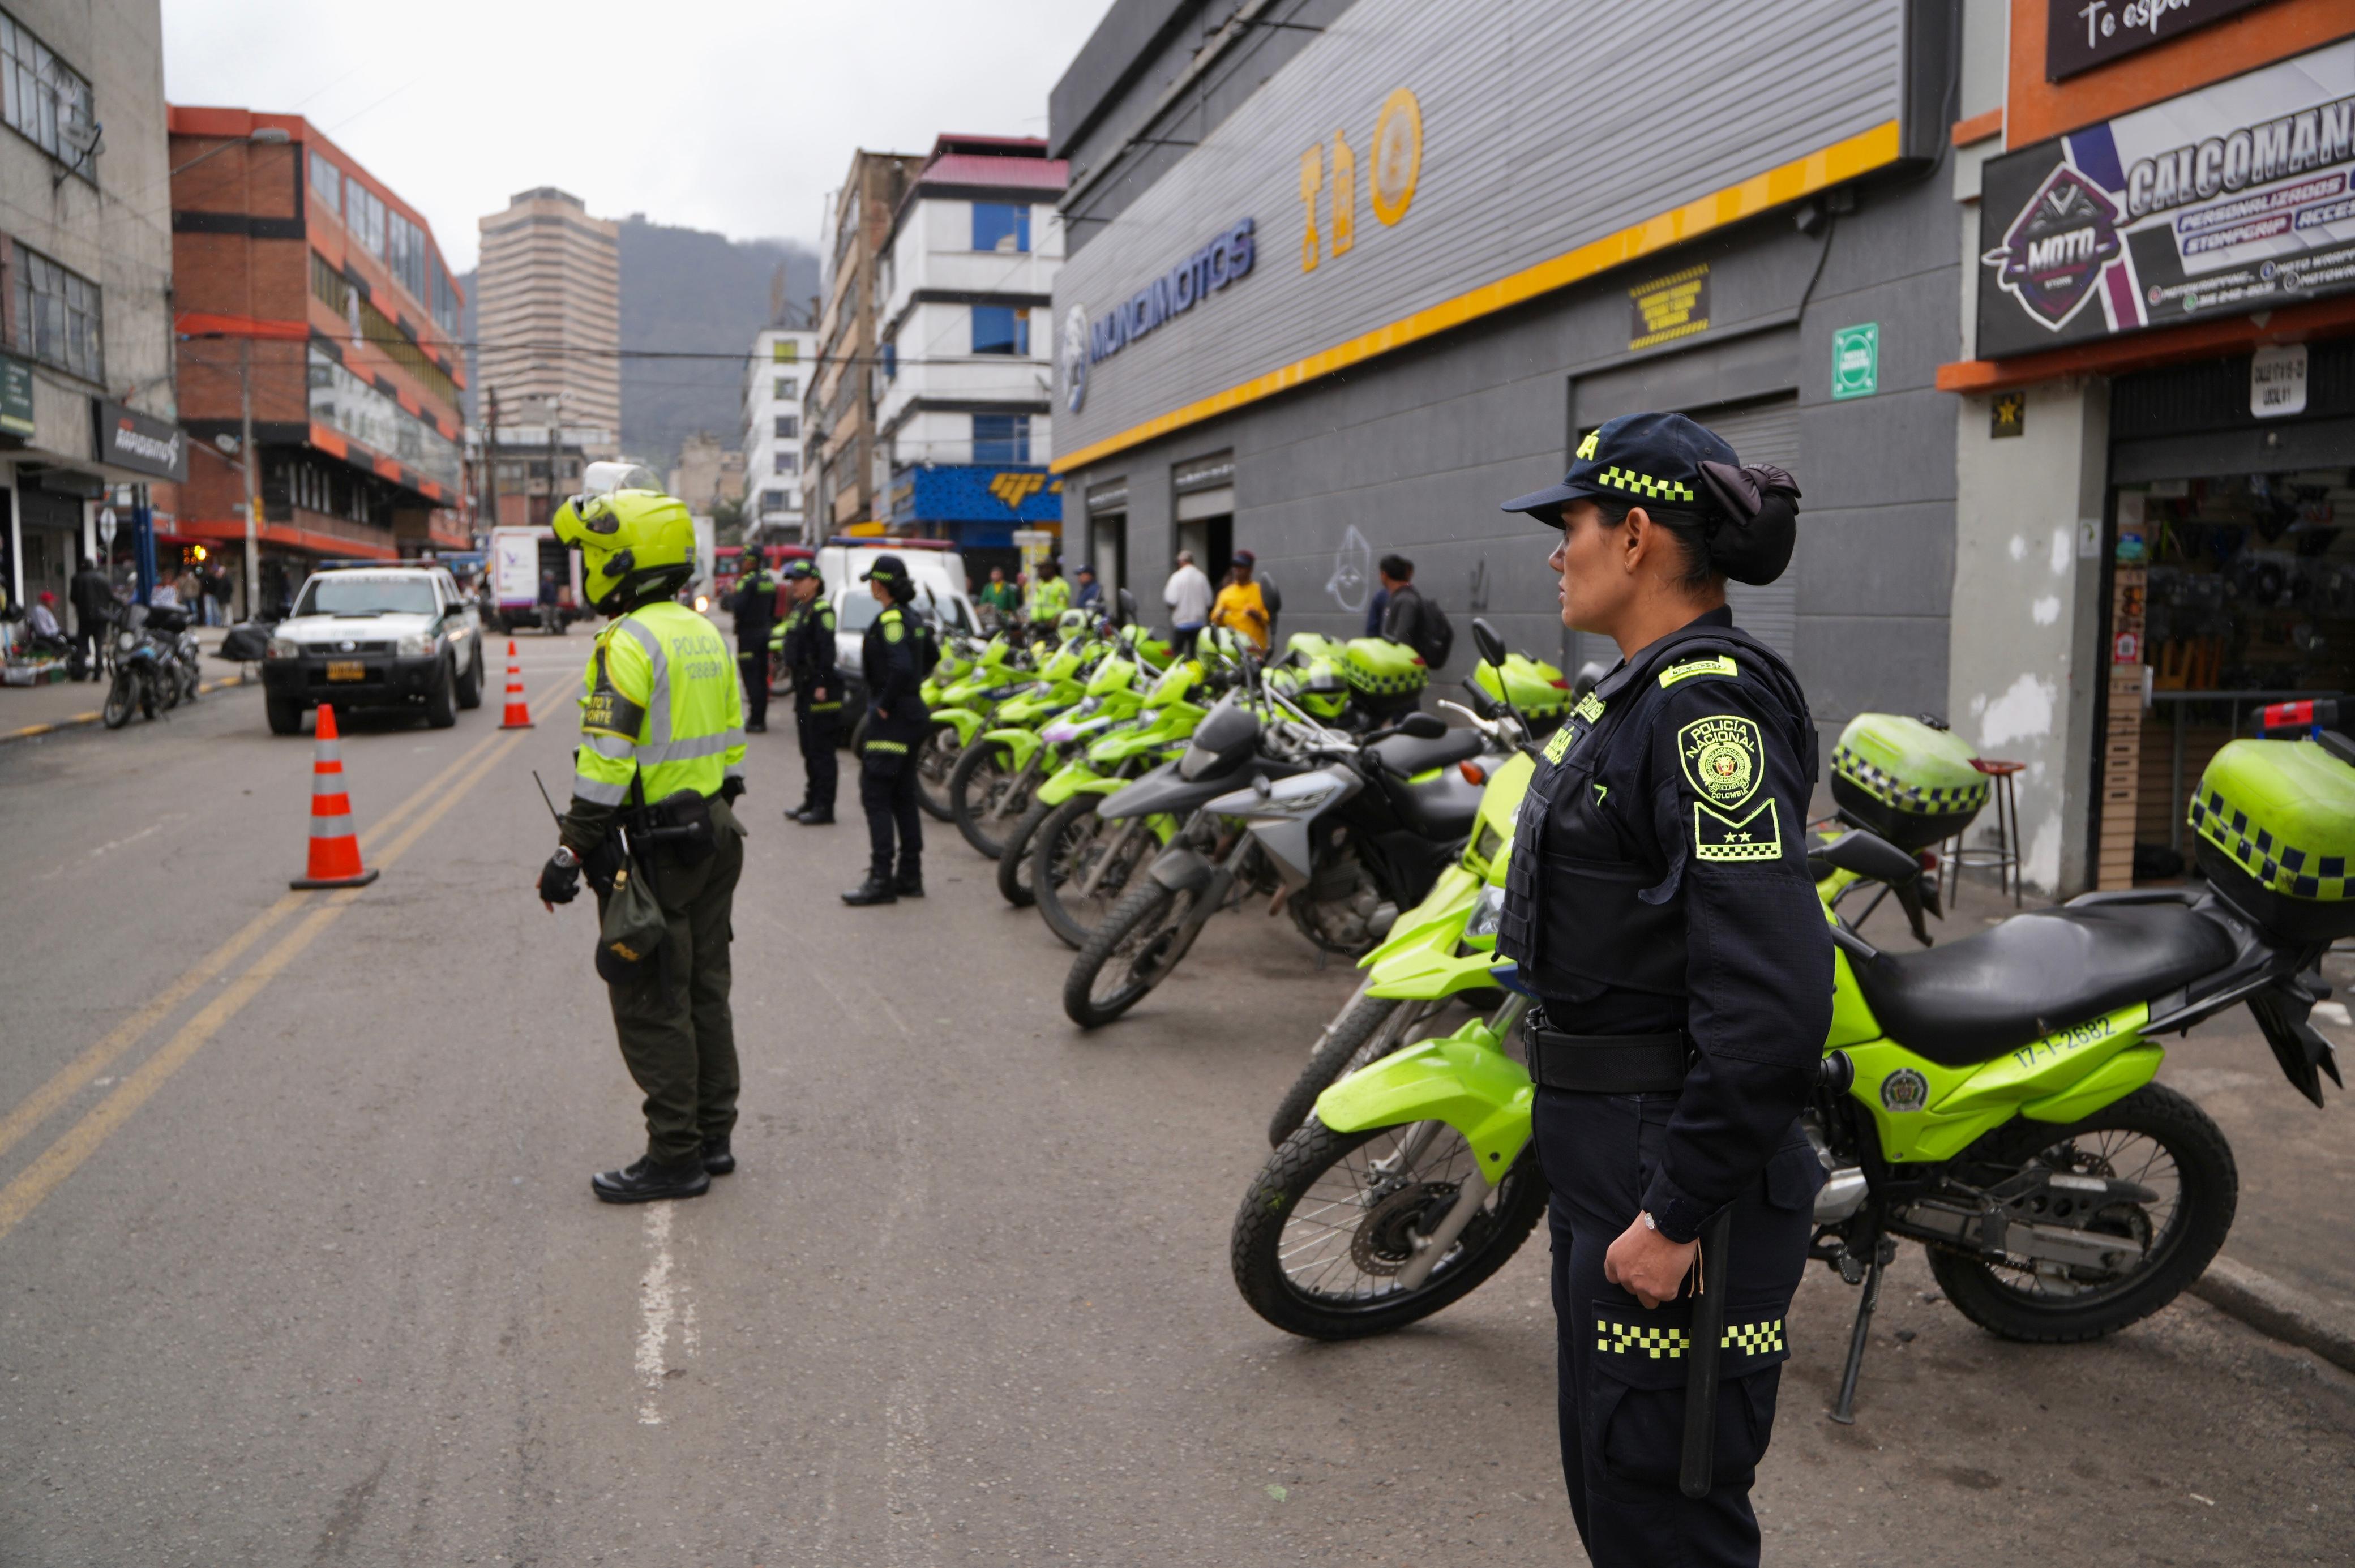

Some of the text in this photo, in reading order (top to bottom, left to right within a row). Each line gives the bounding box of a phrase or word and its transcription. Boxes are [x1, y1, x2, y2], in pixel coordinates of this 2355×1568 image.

[2078, 1, 2116, 49] Te
[2129, 101, 2355, 216] CALCOMAN
[2028, 227, 2096, 274] MOTO
[1091, 217, 1256, 365] MUNDIMOTOS
[1686, 731, 1754, 759] NACIONAL
[1711, 789, 1749, 799] COLOMBIA
[2014, 1017, 2117, 1068] 17-1-2682
